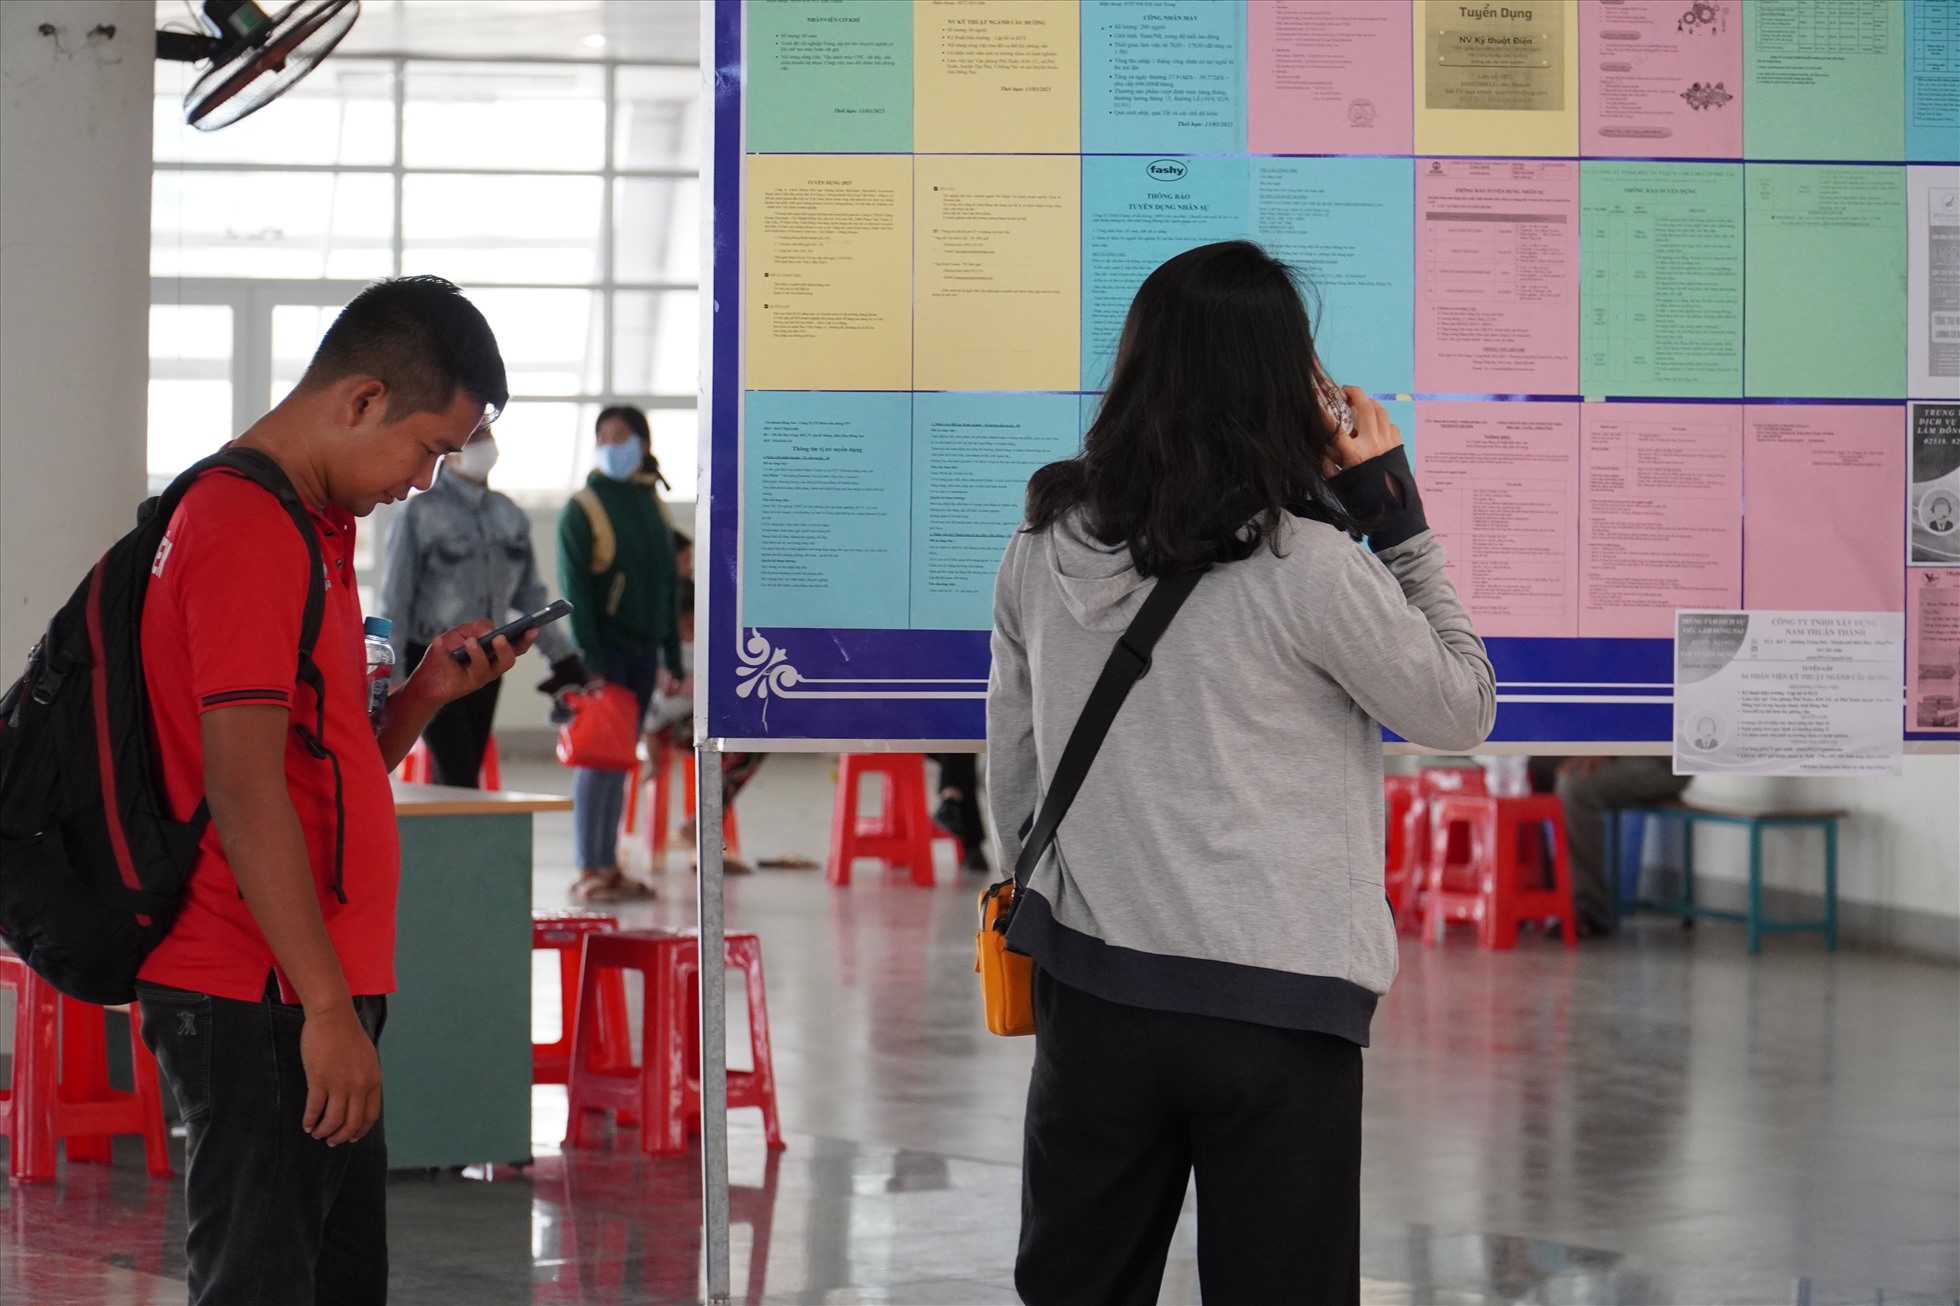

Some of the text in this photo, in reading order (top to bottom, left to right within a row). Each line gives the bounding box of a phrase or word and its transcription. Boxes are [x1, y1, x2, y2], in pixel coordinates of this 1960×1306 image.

[1460, 4, 1532, 21] Tuyển Dụng
[1475, 37, 1485, 45] Kỹ
[1513, 37, 1532, 45] Điện
[1150, 166, 1184, 175] fashy
[1946, 418, 1957, 426] VỤ
[1917, 425, 1936, 434] LÀM
